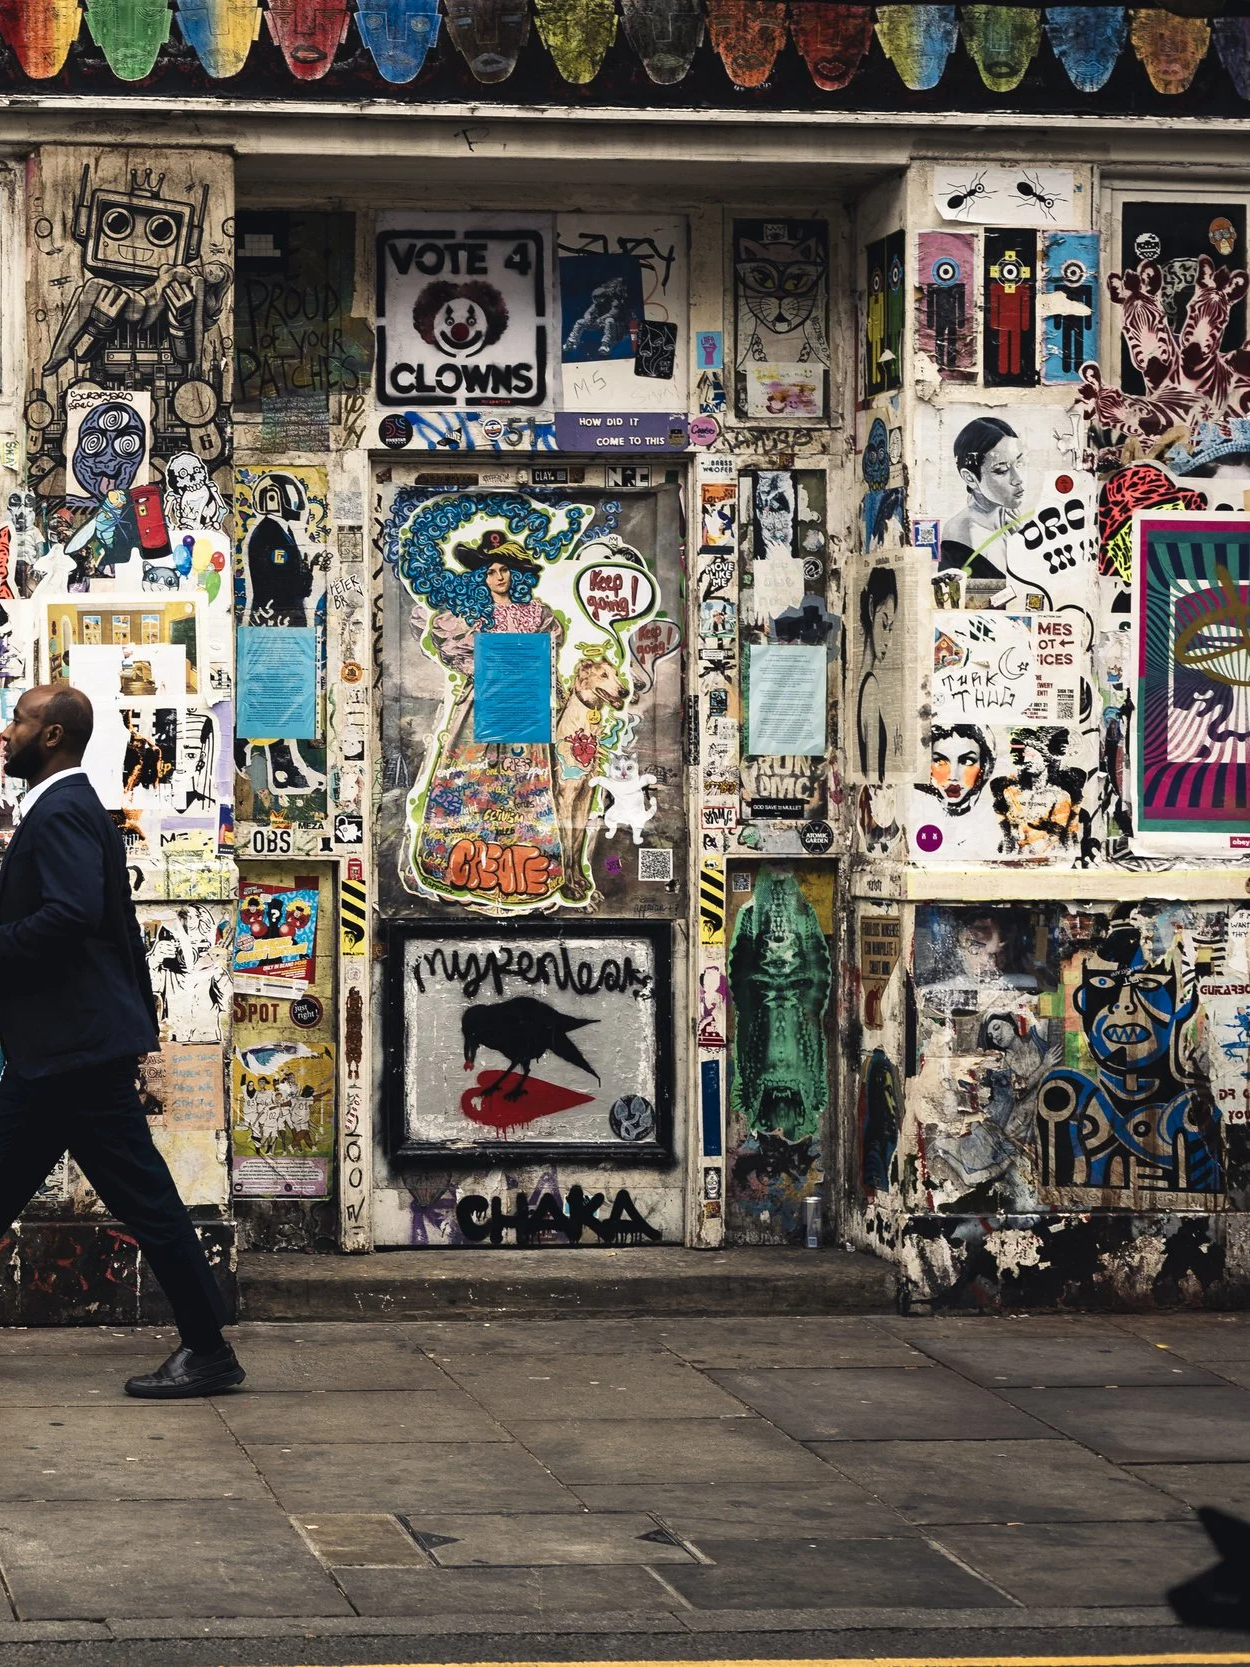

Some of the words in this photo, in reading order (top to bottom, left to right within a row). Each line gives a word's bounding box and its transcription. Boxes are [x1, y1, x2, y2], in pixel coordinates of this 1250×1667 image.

[388, 243, 487, 276] VOTE
[504, 243, 532, 276] 4
[237, 344, 359, 398] PATCHES
[389, 362, 534, 394] CLOWNS
[579, 417, 602, 427] HOW
[607, 417, 623, 426] DID
[630, 417, 639, 426] IT
[507, 417, 536, 447] 51
[596, 437, 625, 447] COME
[629, 436, 642, 446] TO
[645, 436, 665, 446] THIS
[706, 562, 735, 573] MOVE
[1042, 543, 1076, 575] IN
[711, 570, 731, 580] LIKE
[713, 578, 728, 588] ME
[329, 575, 360, 597] PETER
[589, 569, 623, 599] Keep
[297, 822, 324, 830] MEZA
[253, 830, 291, 854] OBS
[1231, 838, 1250, 848] obey
[294, 1003, 308, 1013] just
[1219, 1089, 1236, 1101] DR
[455, 1184, 663, 1246] CHAKA
